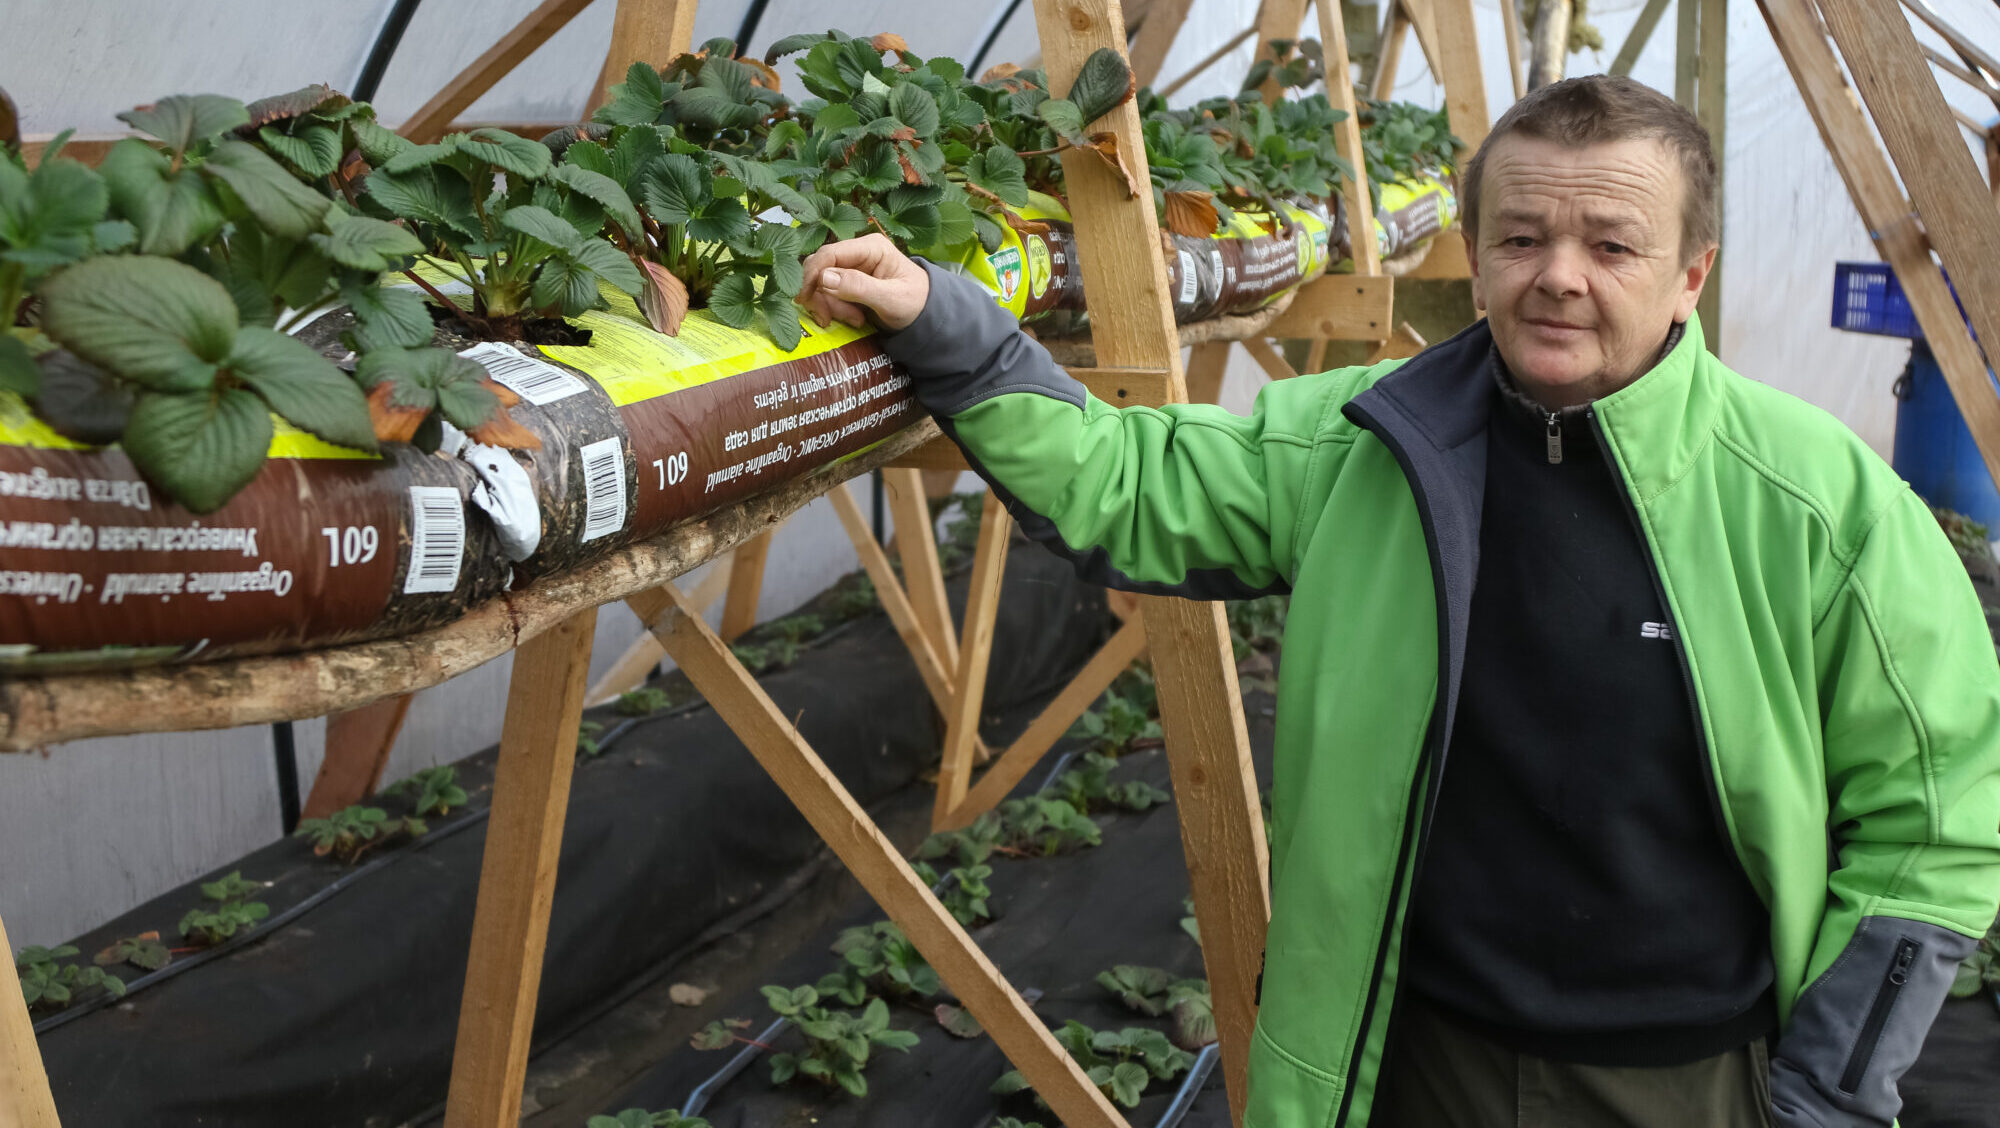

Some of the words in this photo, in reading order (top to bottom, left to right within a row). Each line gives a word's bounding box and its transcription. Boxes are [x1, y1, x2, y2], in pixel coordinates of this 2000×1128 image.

[753, 380, 789, 411] gėlėms
[791, 384, 798, 403] ir
[798, 373, 827, 401] auginti
[752, 420, 769, 443] для
[770, 416, 798, 437] земля
[725, 431, 749, 452] сада
